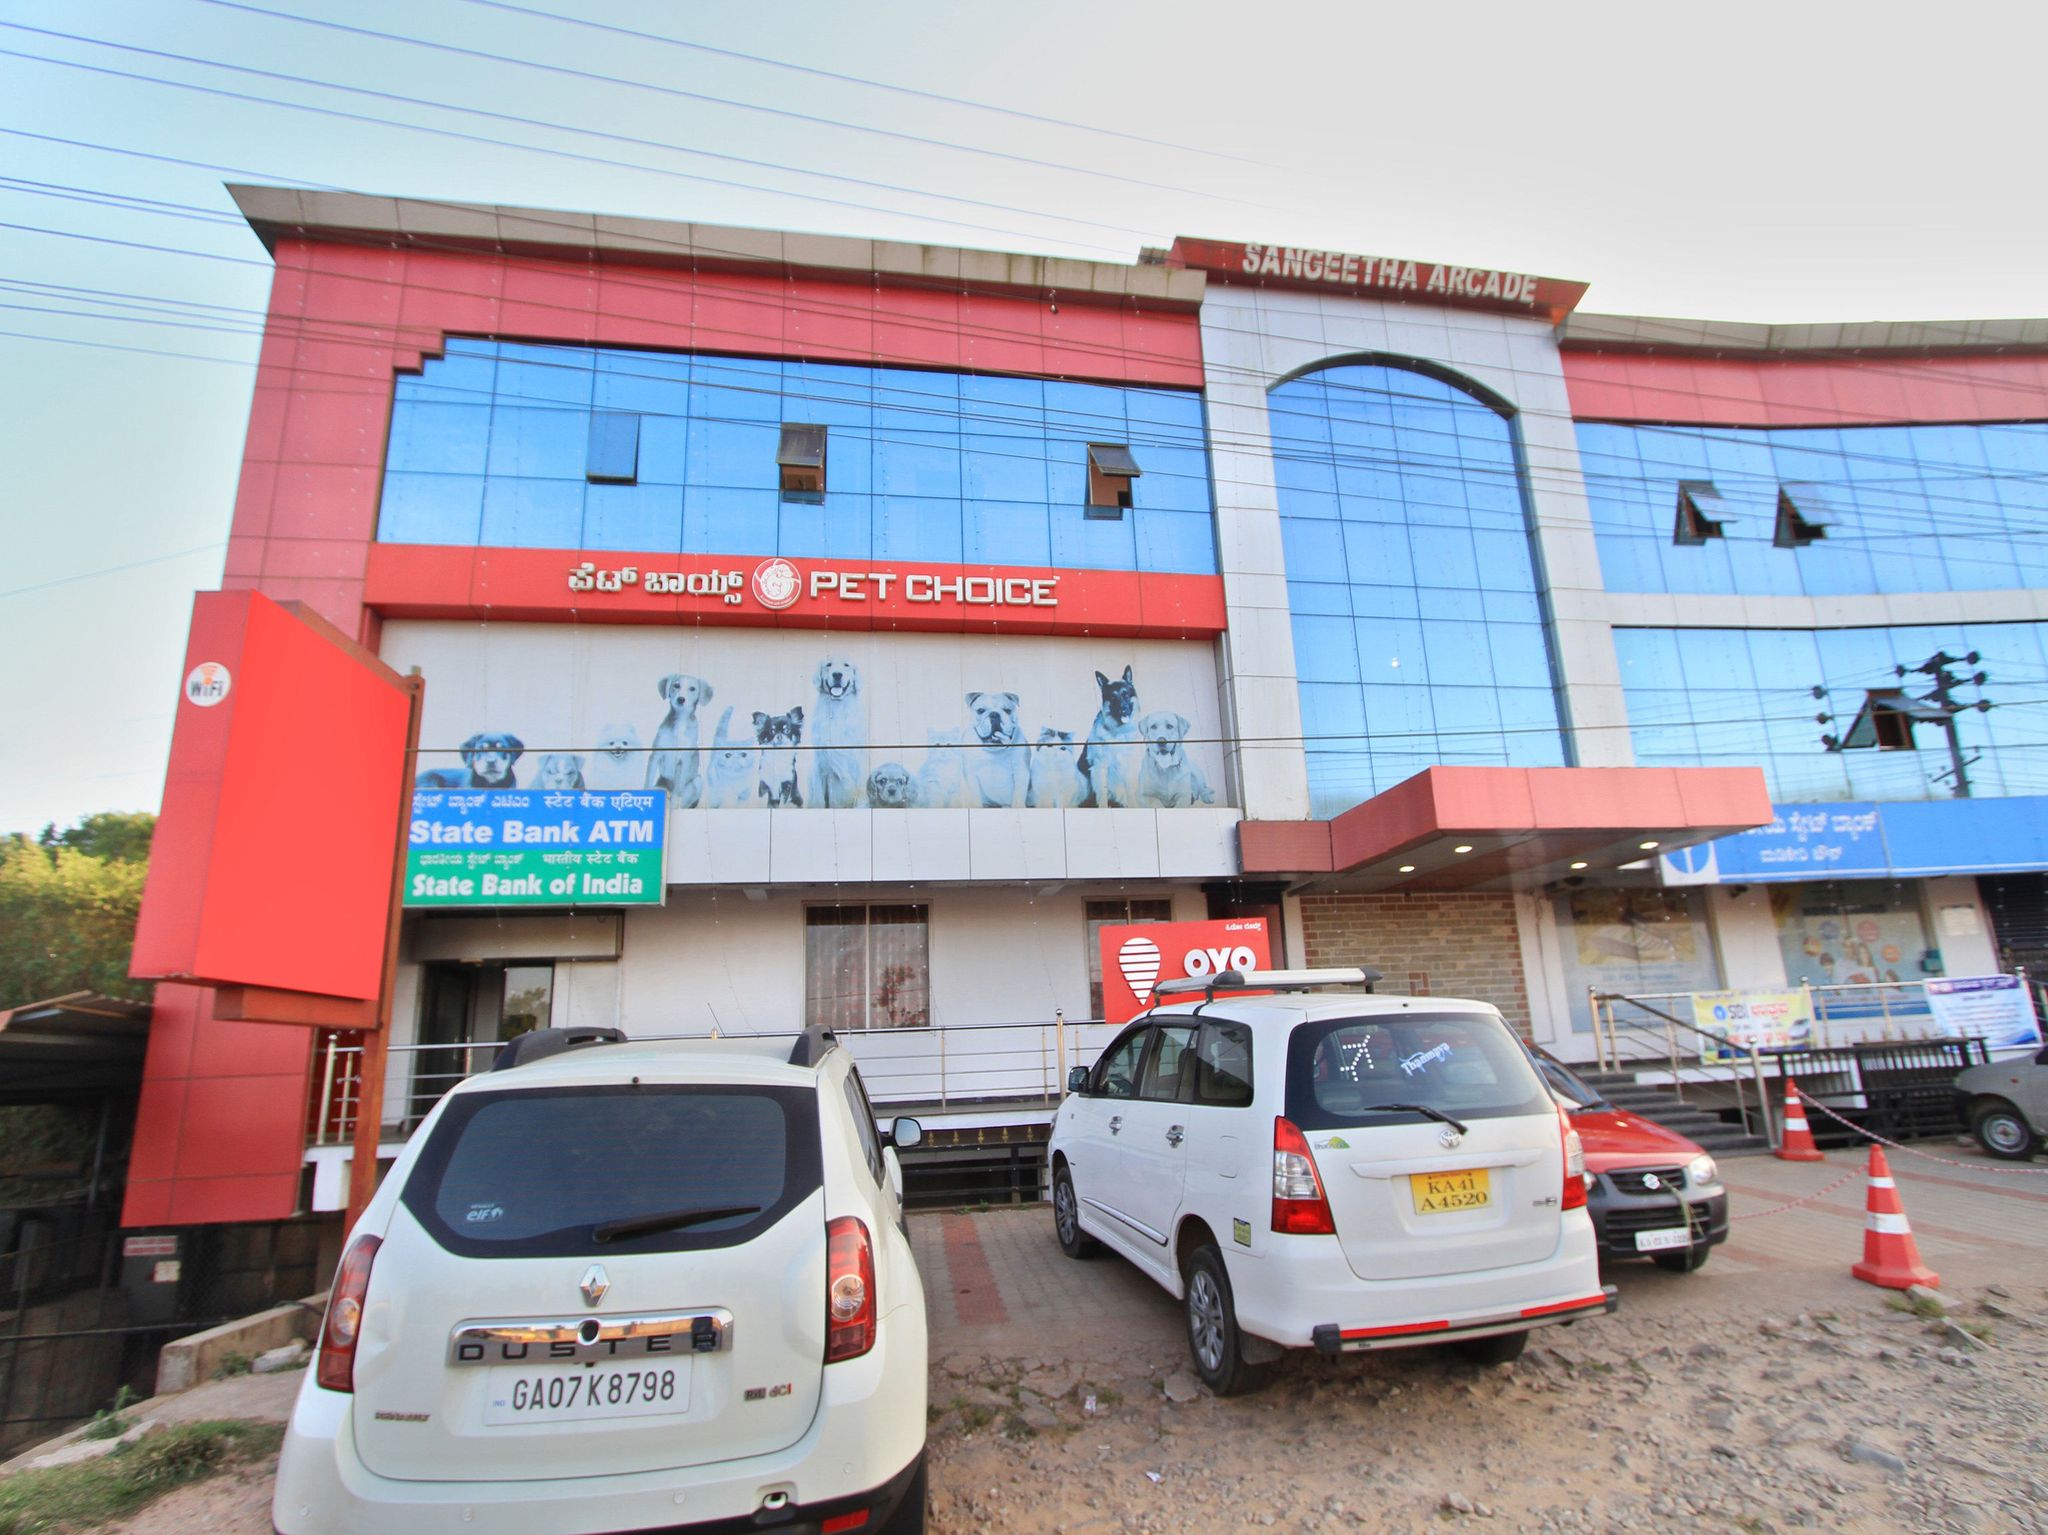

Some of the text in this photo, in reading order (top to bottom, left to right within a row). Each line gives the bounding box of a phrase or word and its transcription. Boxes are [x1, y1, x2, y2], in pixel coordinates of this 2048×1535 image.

[1242, 241, 1539, 303] SANGEETHA ARCADE
[567, 562, 743, 605] ಪೆಟ್ ಚಾಯ್ಸ್
[810, 571, 1058, 606] PET CHOICE
[543, 791, 575, 808] स्टेट
[610, 792, 654, 811] एटिएम
[409, 819, 654, 844] State Bank ATM
[586, 850, 613, 865] स्टेट
[412, 873, 643, 896] State Bank of India
[1184, 946, 1257, 977] OYO
[1427, 1178, 1476, 1194] KA 41
[1421, 1191, 1488, 1212] A4520
[458, 1332, 716, 1361] DUSTER
[512, 1369, 676, 1411] GA07K8798
